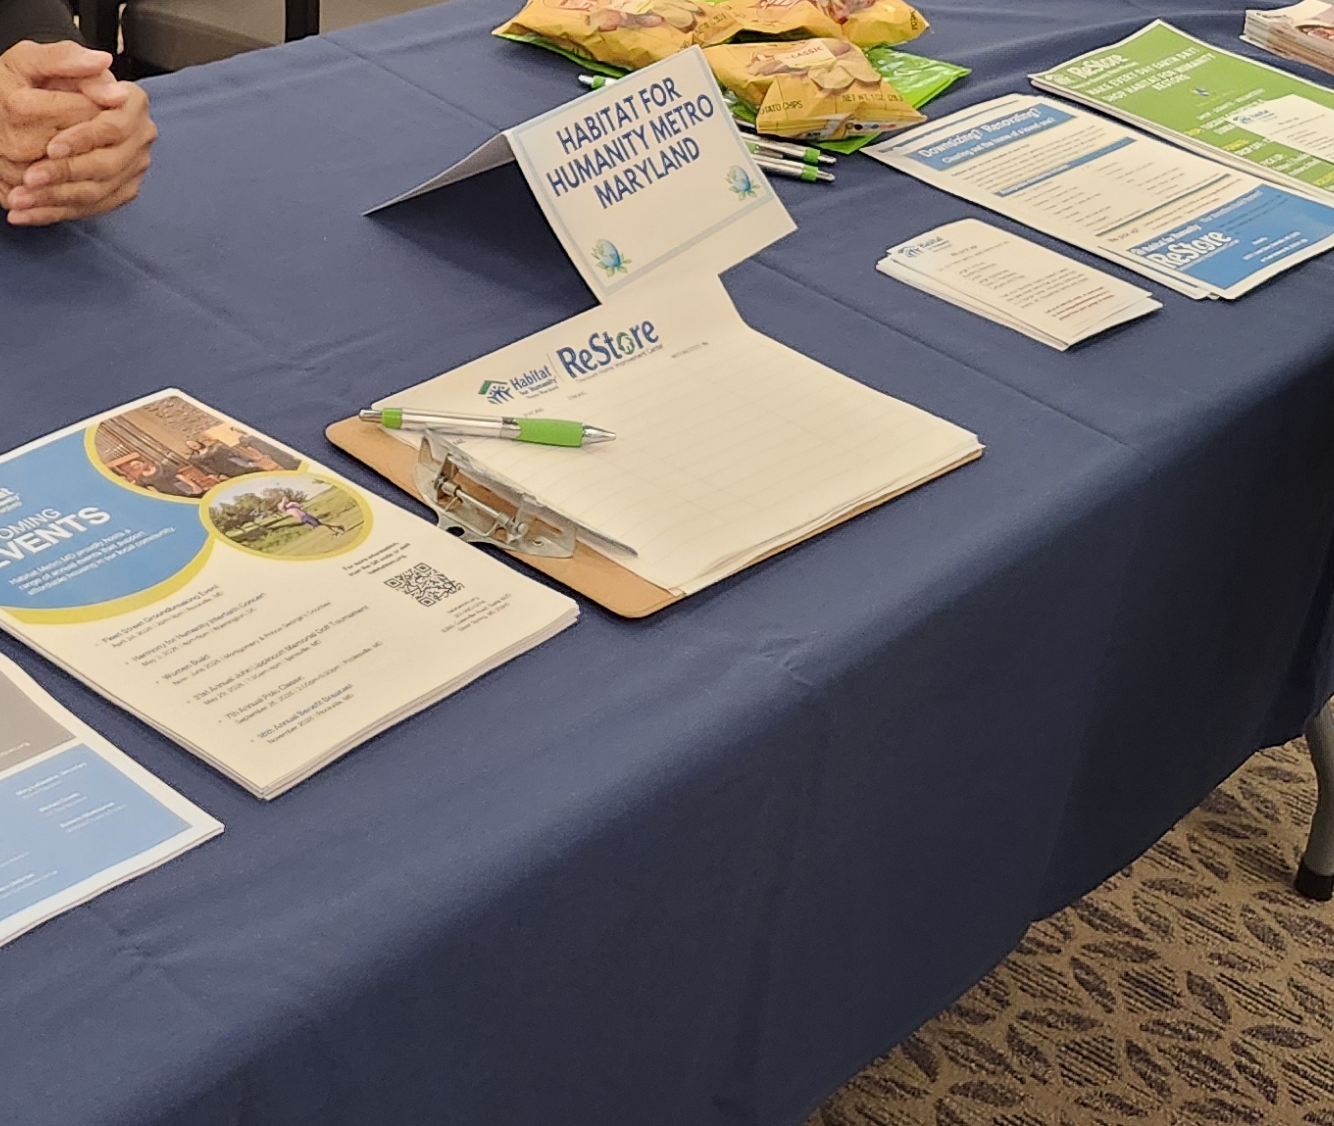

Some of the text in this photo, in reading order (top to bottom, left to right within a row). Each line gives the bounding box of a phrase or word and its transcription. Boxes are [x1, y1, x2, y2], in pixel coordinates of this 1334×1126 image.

[1067, 54, 1129, 78] ReStore
[556, 77, 682, 155] HABITAT FOR
[760, 100, 803, 115] OTATO CHIPS
[842, 94, 855, 102] NET
[546, 94, 714, 197] HUMANITY METRO
[918, 108, 1041, 158] Downsizing? Renovating?
[594, 137, 700, 209] MARYLAND
[1146, 231, 1231, 268] ReStore
[557, 320, 659, 378] ReStore
[510, 365, 552, 391] Habitat
[519, 376, 557, 396] for Humanity
[7, 569, 40, 584] Habitat
[35, 559, 63, 572] Metro
[59, 552, 77, 561] MD
[73, 540, 105, 556] proudly
[100, 530, 126, 543] hosts
[16, 577, 44, 590] range
[48, 561, 78, 576] annual
[74, 550, 103, 564] events
[99, 543, 118, 552] that
[114, 530, 148, 546] support
[25, 575, 68, 595] affordable
[65, 562, 99, 578] housing
[103, 552, 119, 560] our
[115, 544, 136, 554] local
[131, 643, 168, 662] Harmony
[163, 636, 179, 645] for
[175, 621, 211, 640] Humanity
[237, 592, 268, 608] Concert
[207, 676, 235, 692] Annual
[232, 667, 253, 678] John
[282, 631, 319, 651] Memorial
[314, 624, 332, 634] Golf
[328, 604, 370, 626] Tournament
